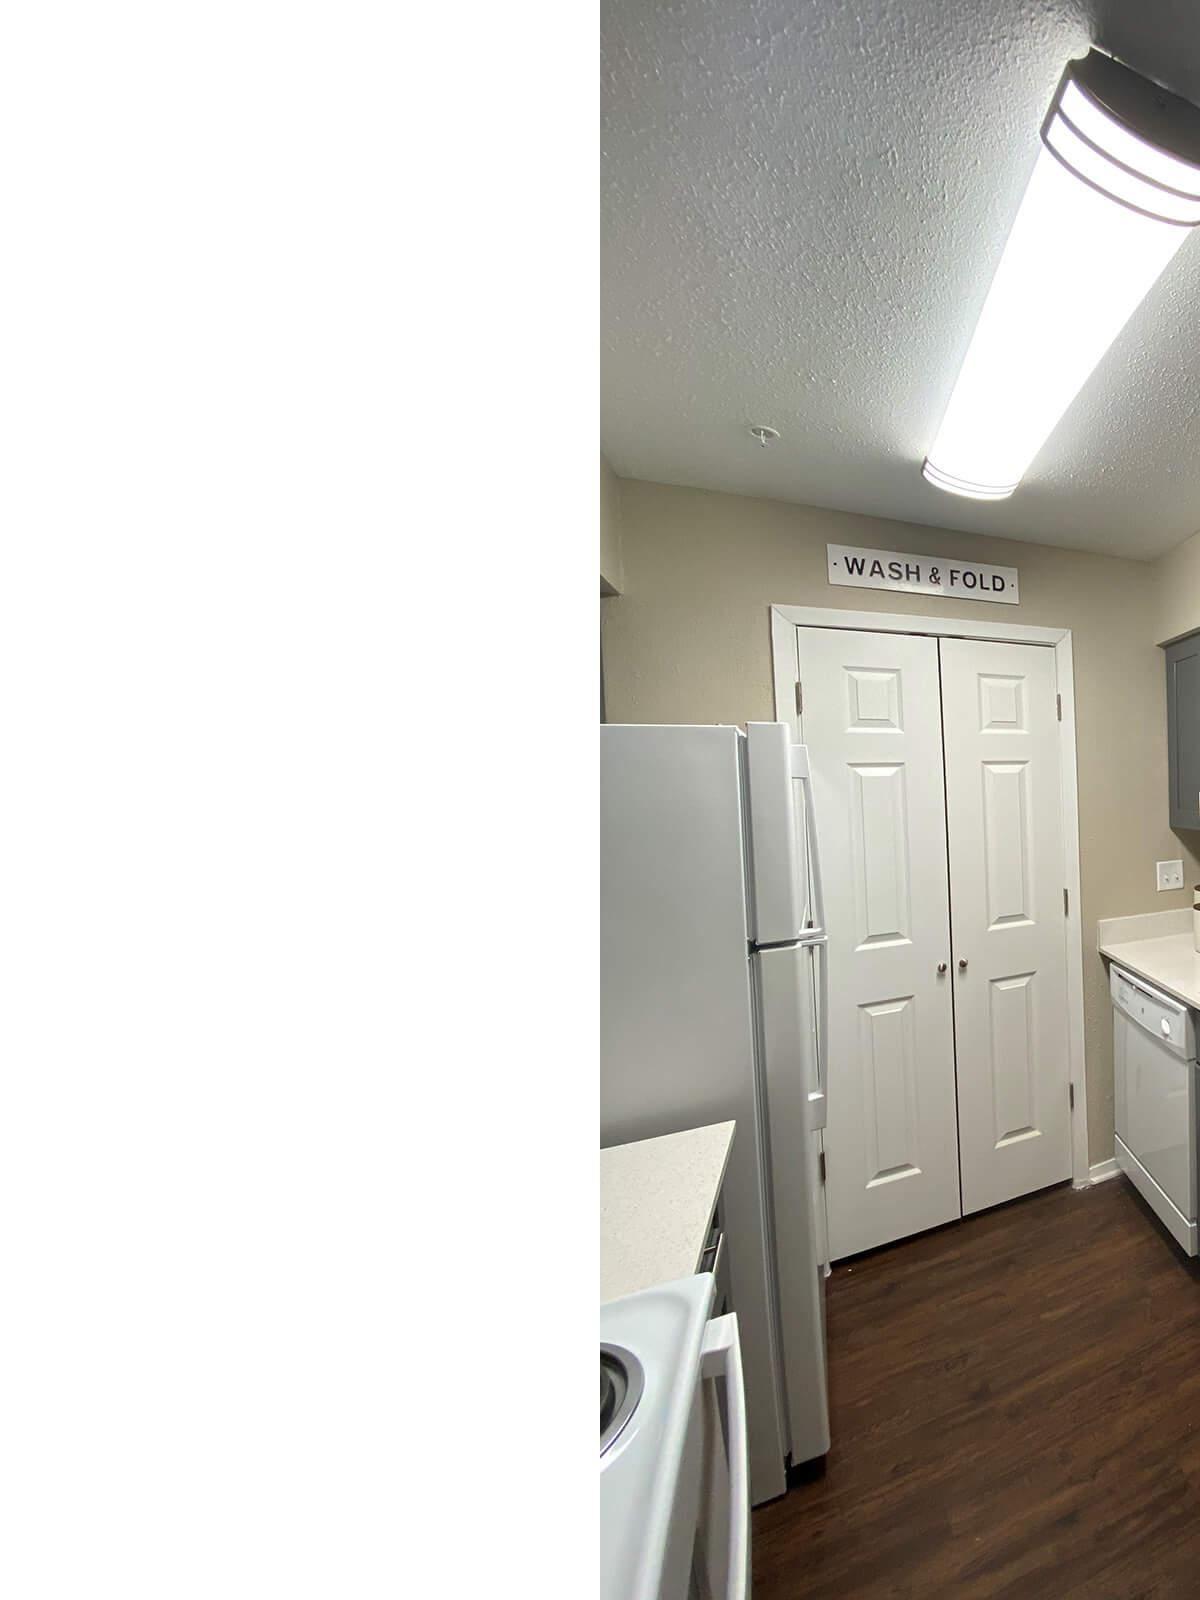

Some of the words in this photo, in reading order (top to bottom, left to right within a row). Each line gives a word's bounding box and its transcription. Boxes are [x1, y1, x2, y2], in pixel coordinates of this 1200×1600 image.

[844, 556, 921, 582] WASH
[929, 566, 941, 585] &
[950, 569, 1005, 592] FOLD
